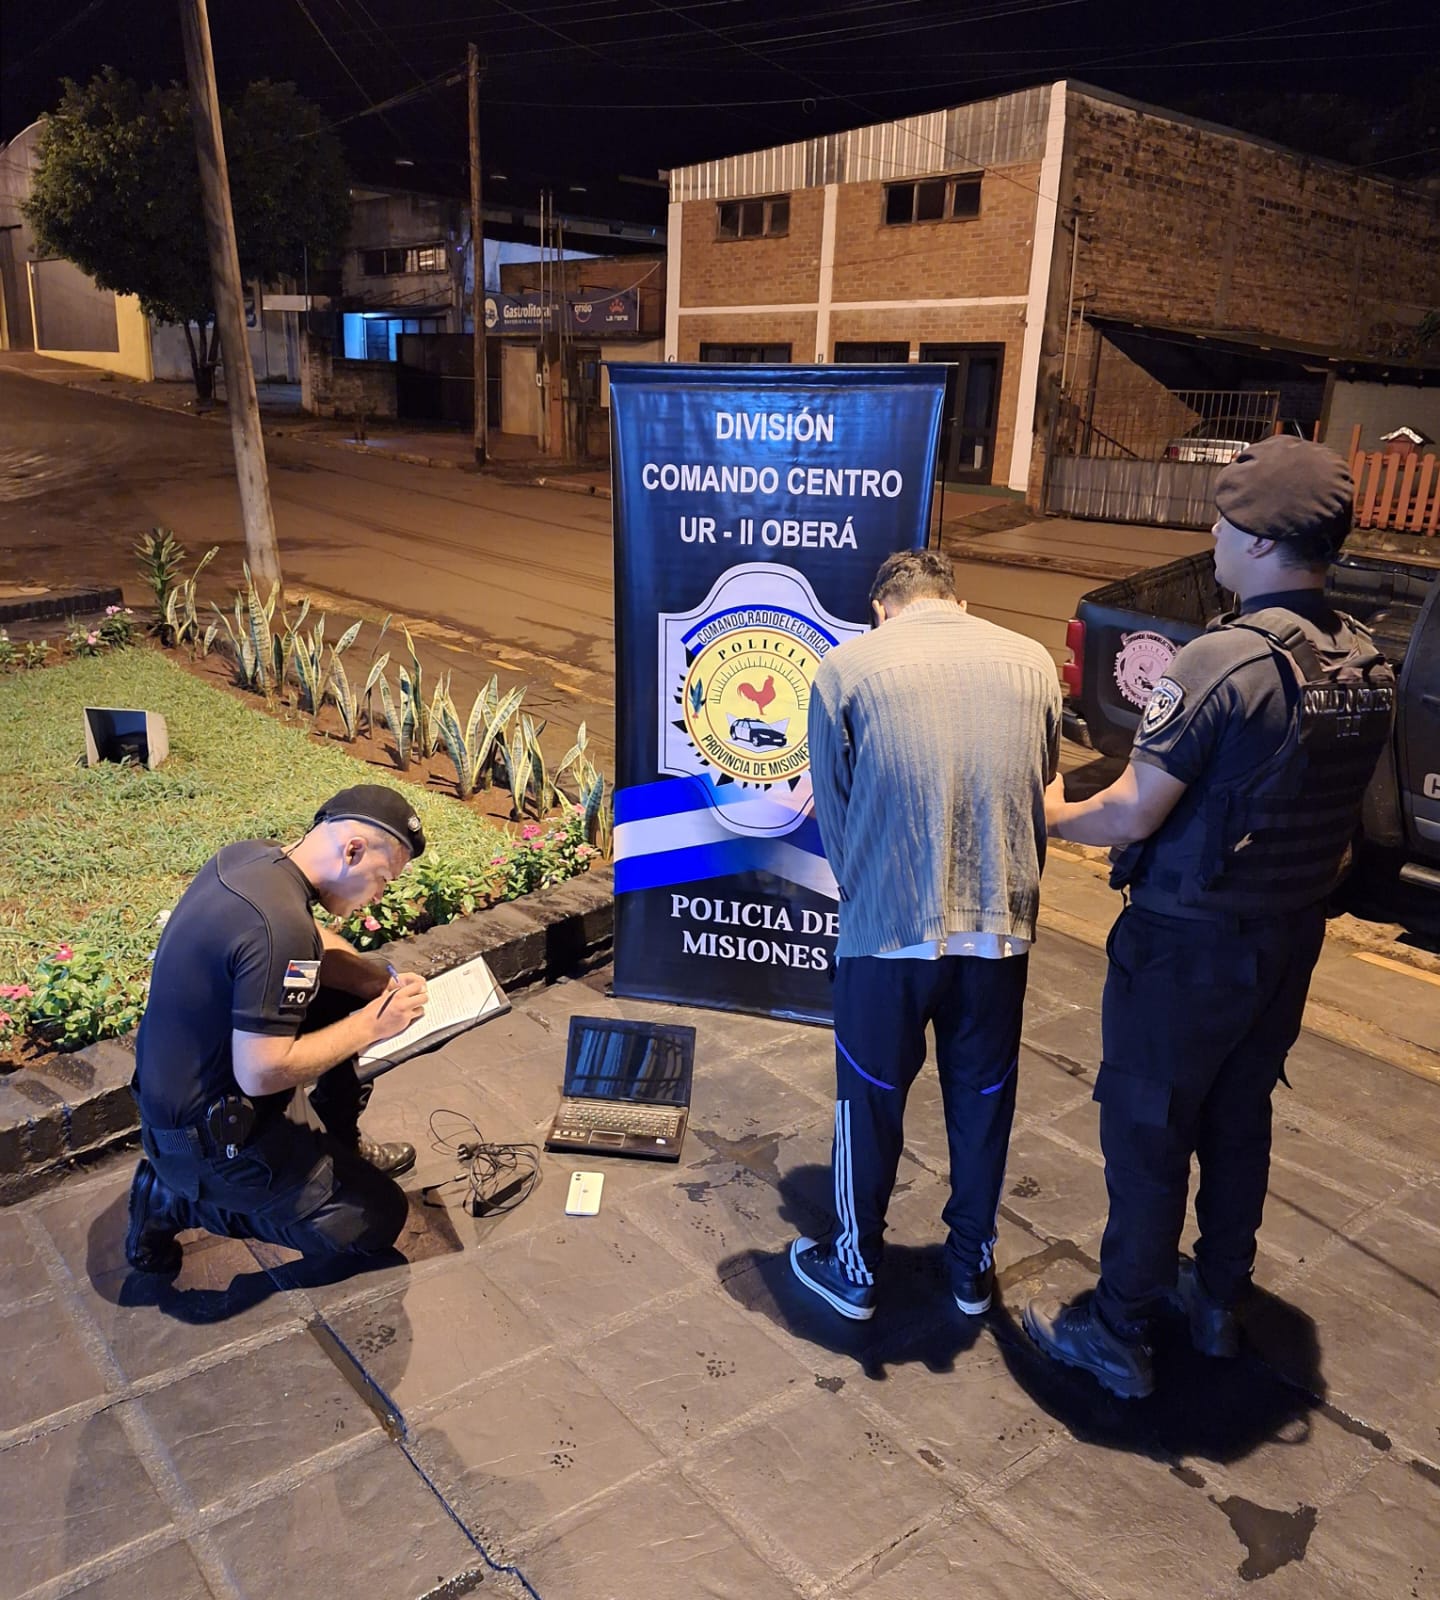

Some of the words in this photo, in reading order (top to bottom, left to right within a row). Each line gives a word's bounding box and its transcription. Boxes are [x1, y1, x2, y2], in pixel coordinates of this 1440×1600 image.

[715, 406, 834, 442] DIVISIÓN
[642, 463, 779, 494] COMANDO
[787, 467, 903, 498] CENTRO
[680, 516, 716, 544] UR
[740, 518, 754, 545] II
[761, 515, 858, 550] OBERÁ
[696, 612, 745, 644] COMANDO
[747, 611, 831, 655] RADIOELECTRICO
[718, 638, 807, 667] POLICIA
[701, 734, 750, 775] PROVINCIA
[753, 762, 767, 776] DE
[768, 742, 809, 776] MISIONES
[670, 893, 794, 932] POLICIA
[800, 909, 841, 937] DE
[682, 930, 829, 970] MISIONES
